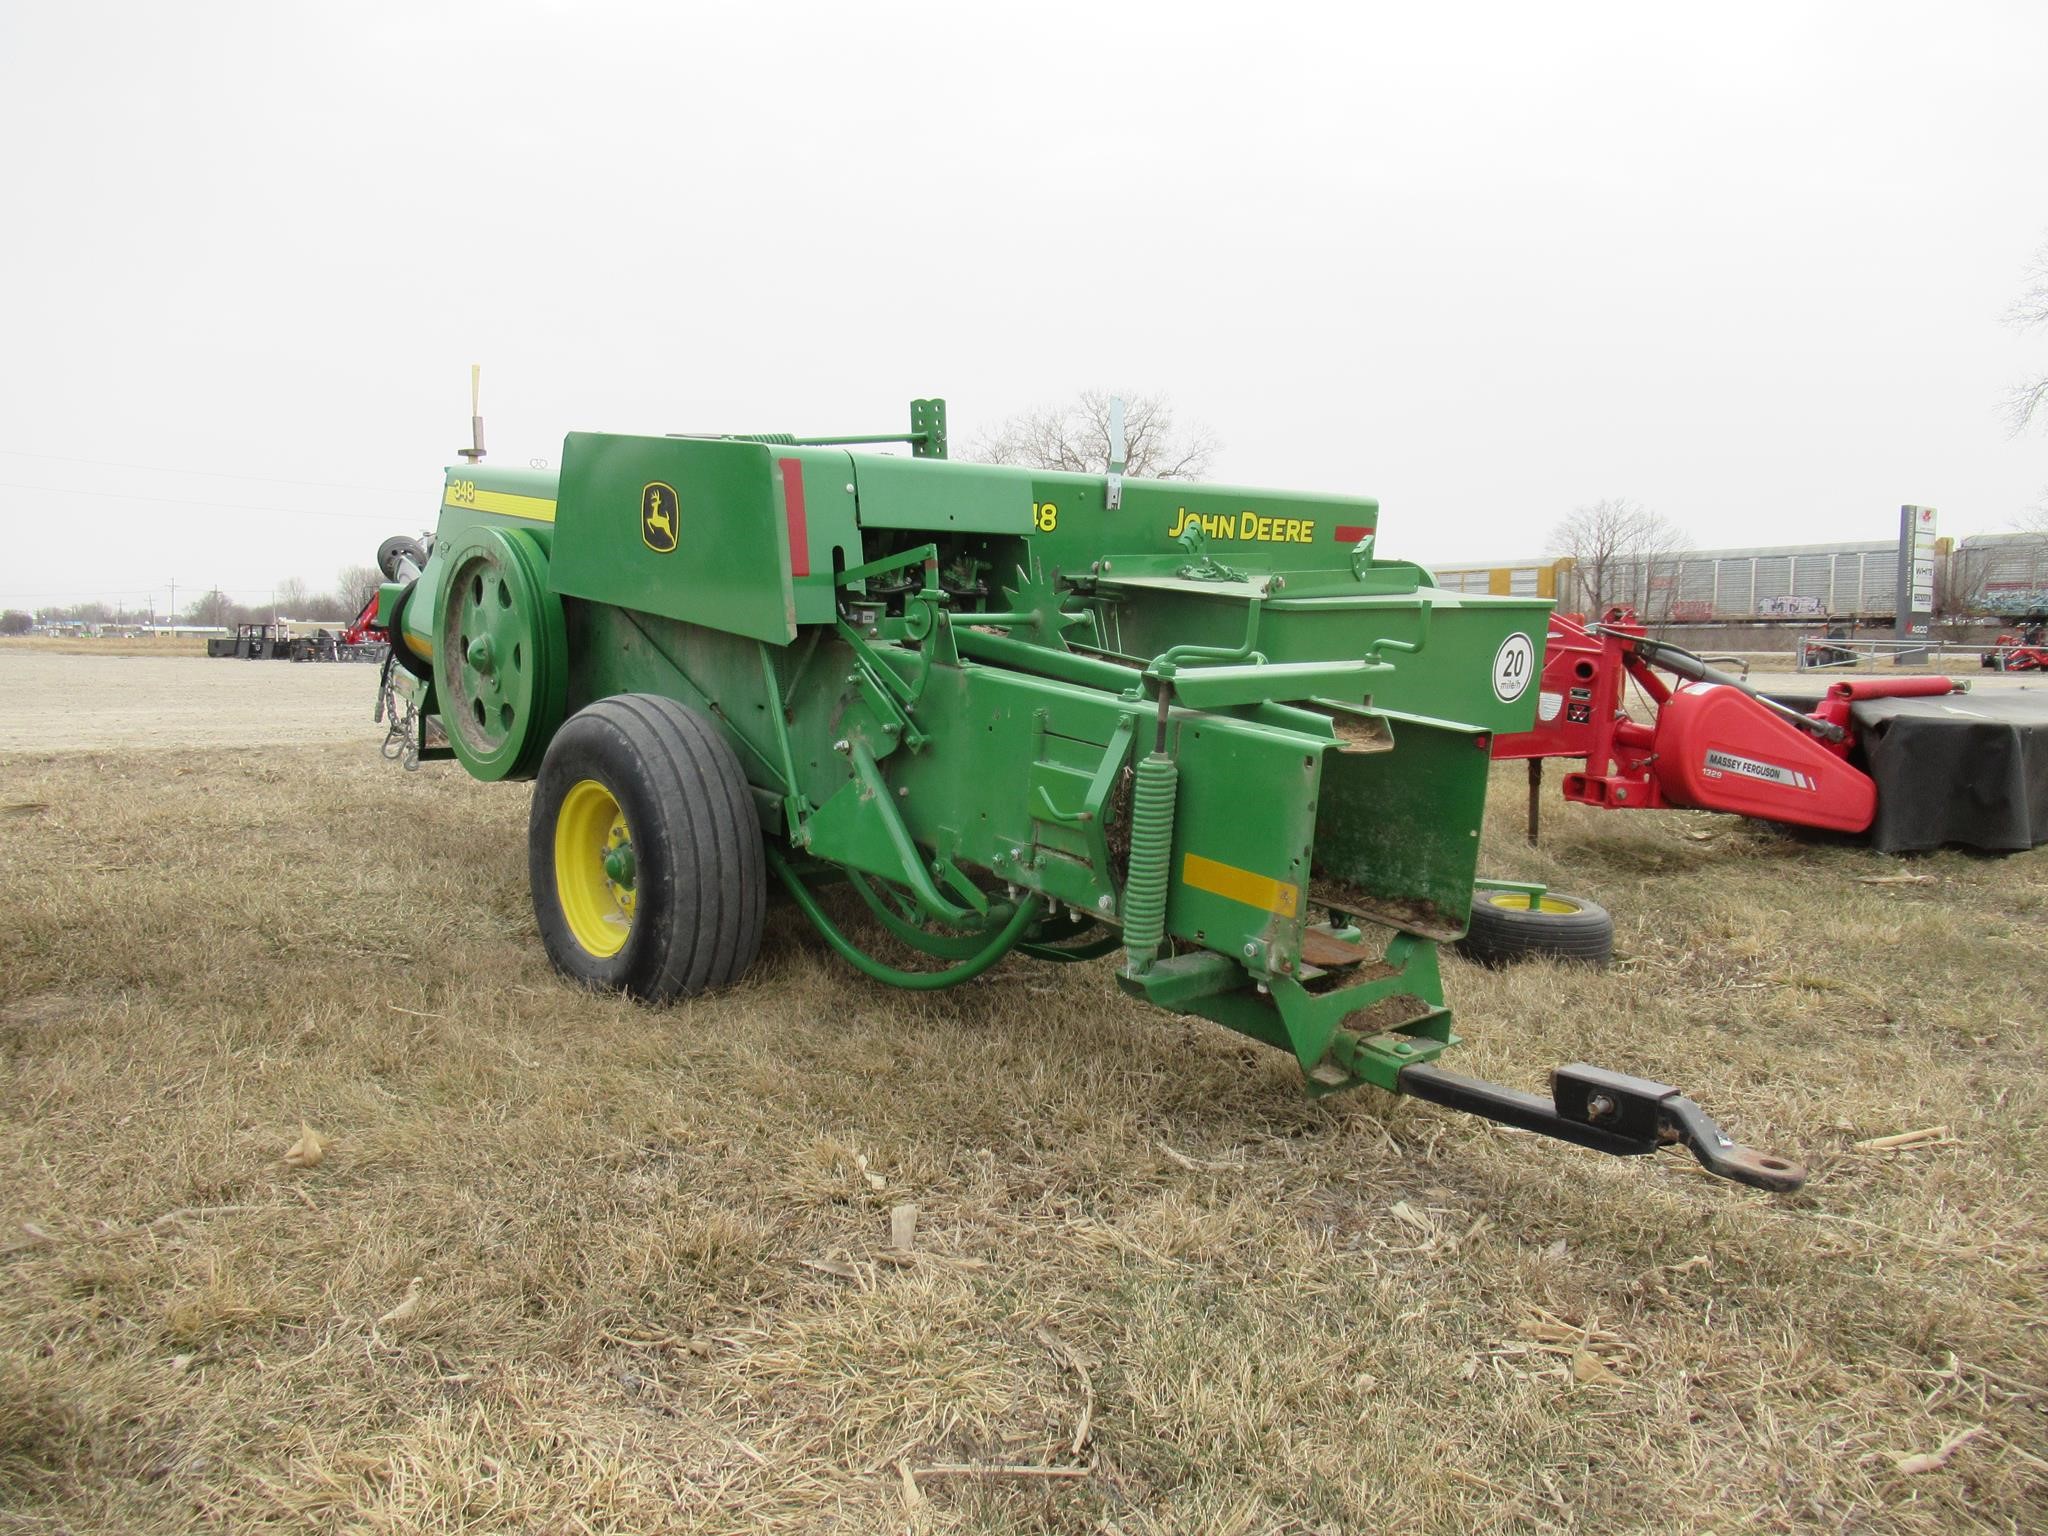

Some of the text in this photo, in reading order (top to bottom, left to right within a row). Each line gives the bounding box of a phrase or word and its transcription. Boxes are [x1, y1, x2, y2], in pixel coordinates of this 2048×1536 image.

[454, 479, 475, 501] 348
[1239, 511, 1315, 543] DEERE
[1503, 649, 1525, 678] 20
[1500, 680, 1521, 690] mile/h
[1709, 754, 1781, 780] MASSEY FERGUSON
